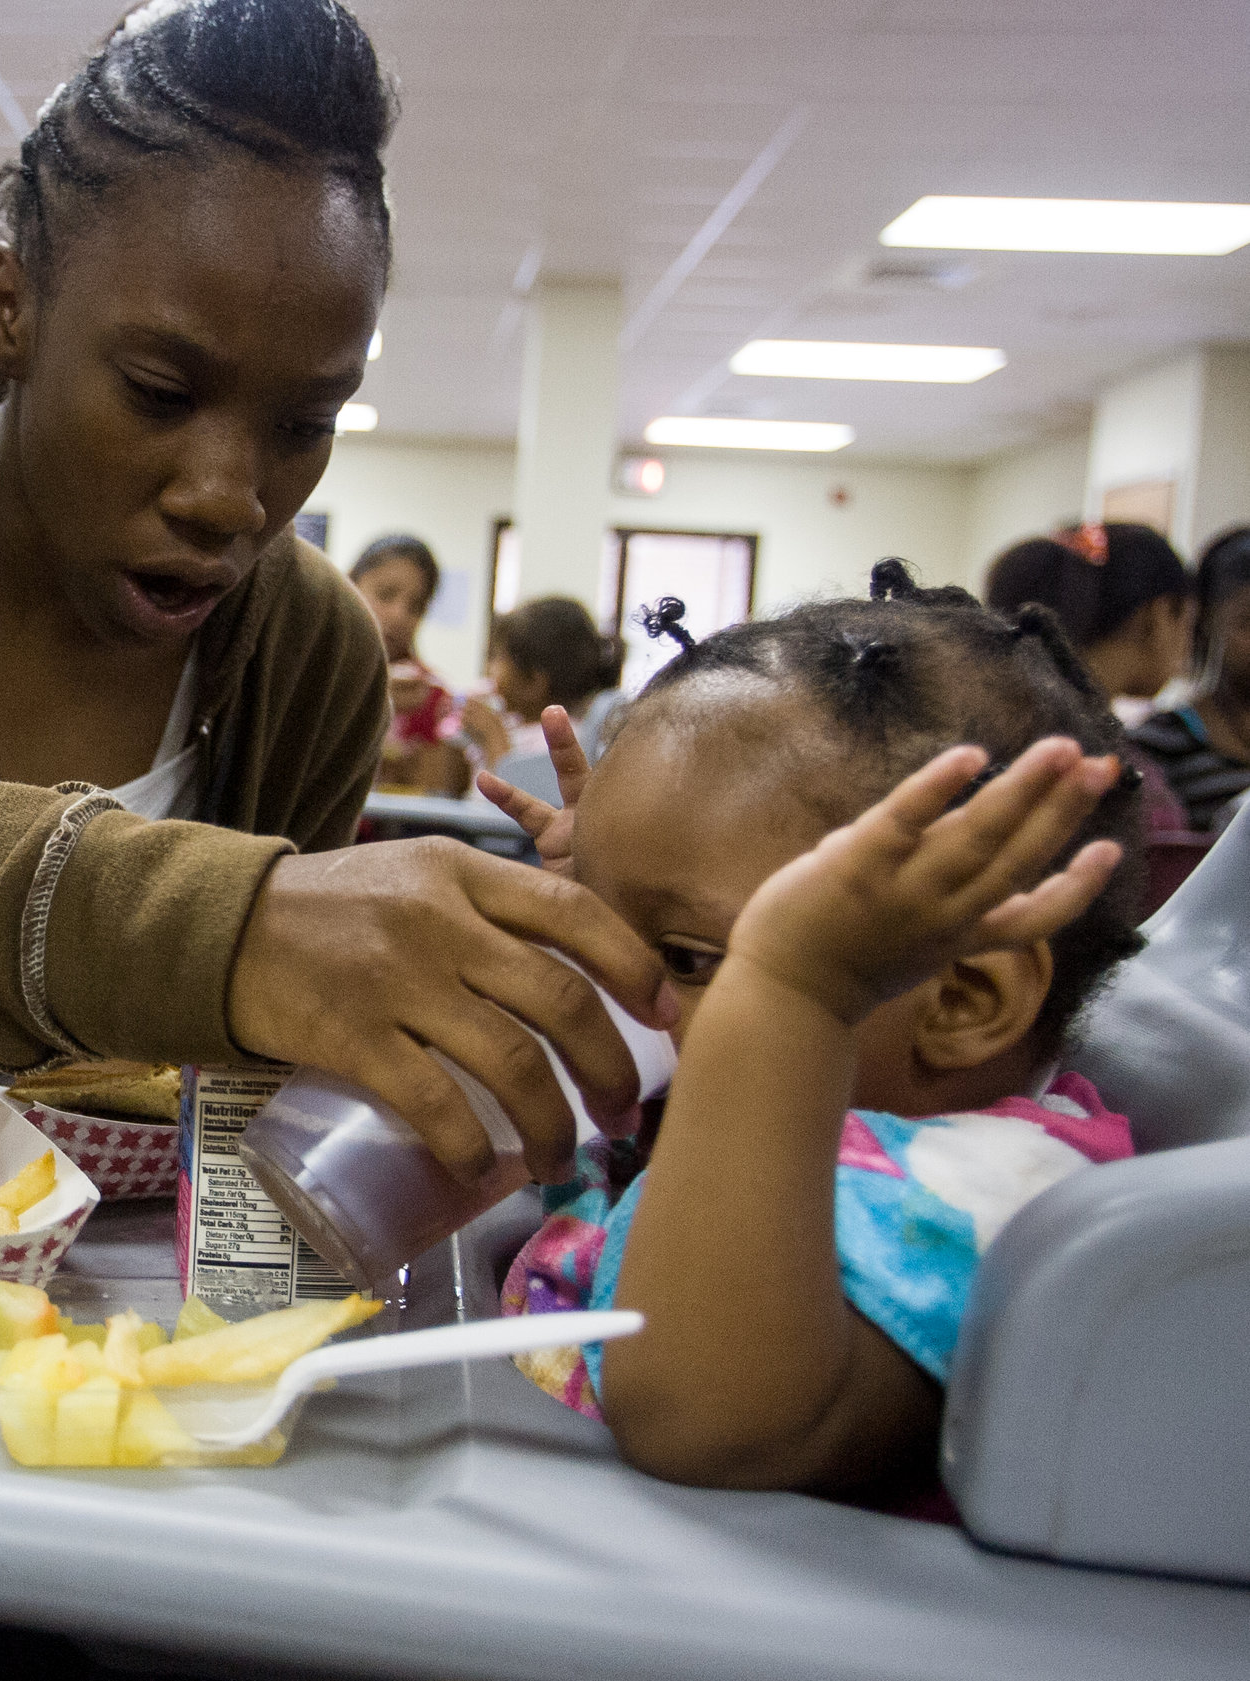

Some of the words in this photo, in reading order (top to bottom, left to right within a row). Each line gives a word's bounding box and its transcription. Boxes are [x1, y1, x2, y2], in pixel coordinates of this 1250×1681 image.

[204, 1104, 258, 1118] Nutrition
[204, 1118, 228, 1126] Serving
[202, 1144, 226, 1152] Calories
[202, 1166, 218, 1174] Total
[232, 1168, 246, 1178] 2.5g
[208, 1178, 238, 1188] Saturated
[240, 1180, 250, 1188] Fat
[208, 1189, 225, 1197] Trans
[238, 1191, 246, 1200] 0g
[200, 1198, 238, 1208] Cholesterol
[239, 1202, 257, 1210] 10mg
[200, 1208, 224, 1217] Sodium
[225, 1211, 248, 1220] 115mg
[200, 1219, 216, 1227] Total
[218, 1220, 235, 1228] Carb.
[236, 1222, 248, 1230] 28g
[206, 1230, 228, 1240] Dietary
[246, 1233, 254, 1241] 0g
[205, 1241, 227, 1250] Sugars
[228, 1242, 240, 1250] 27g
[198, 1250, 222, 1258] Protein
[222, 1252, 231, 1260] 8g
